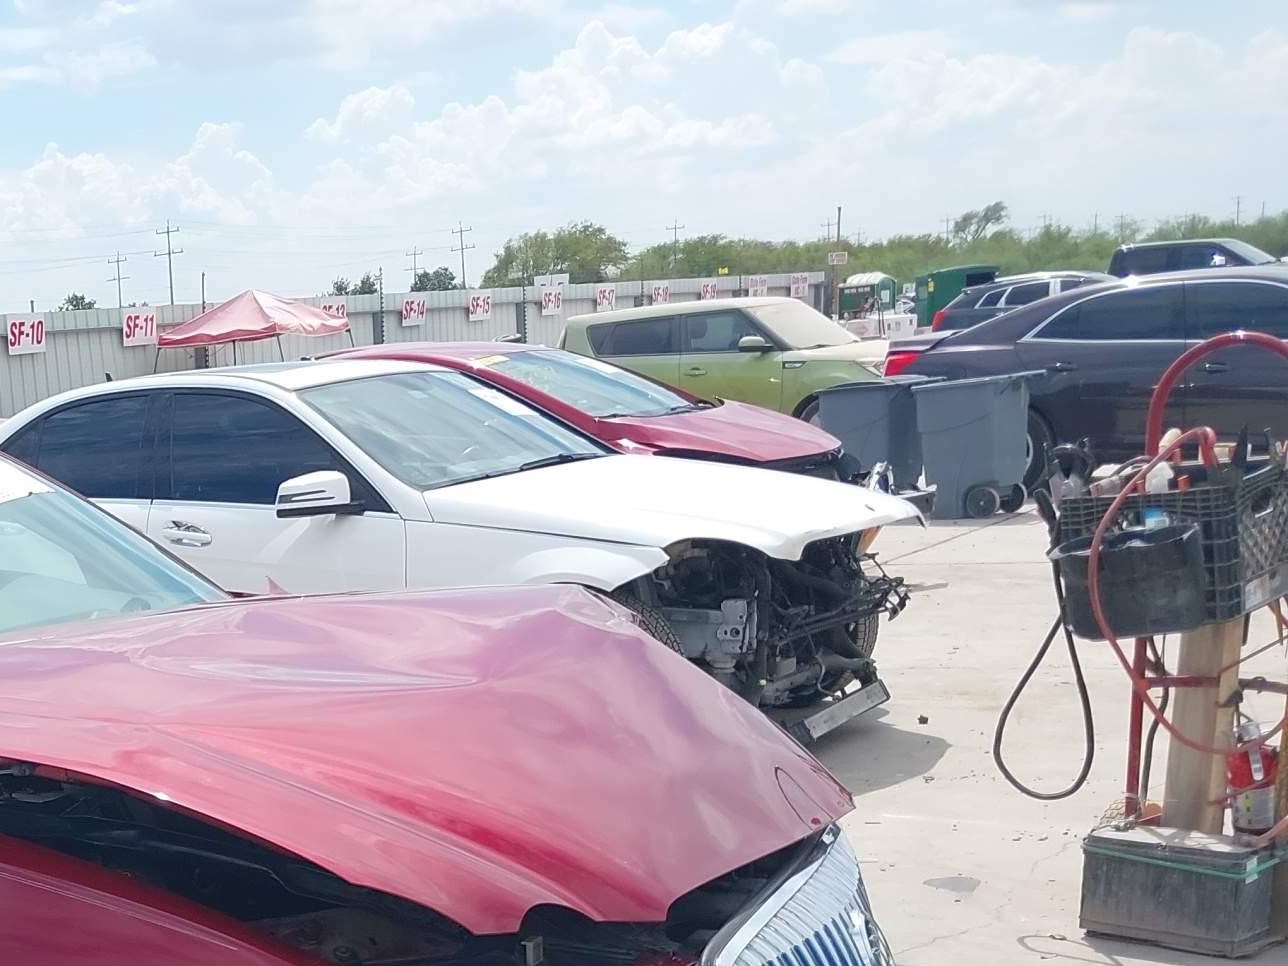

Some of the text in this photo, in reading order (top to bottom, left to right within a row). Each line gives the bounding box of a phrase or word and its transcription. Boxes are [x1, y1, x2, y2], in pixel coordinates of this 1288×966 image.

[471, 296, 491, 314] SF-15
[543, 292, 561, 309] SF-16
[598, 289, 615, 306] SF-17
[404, 300, 425, 320] SF-14
[9, 320, 43, 347] SF-10
[125, 315, 154, 338] SF-11
